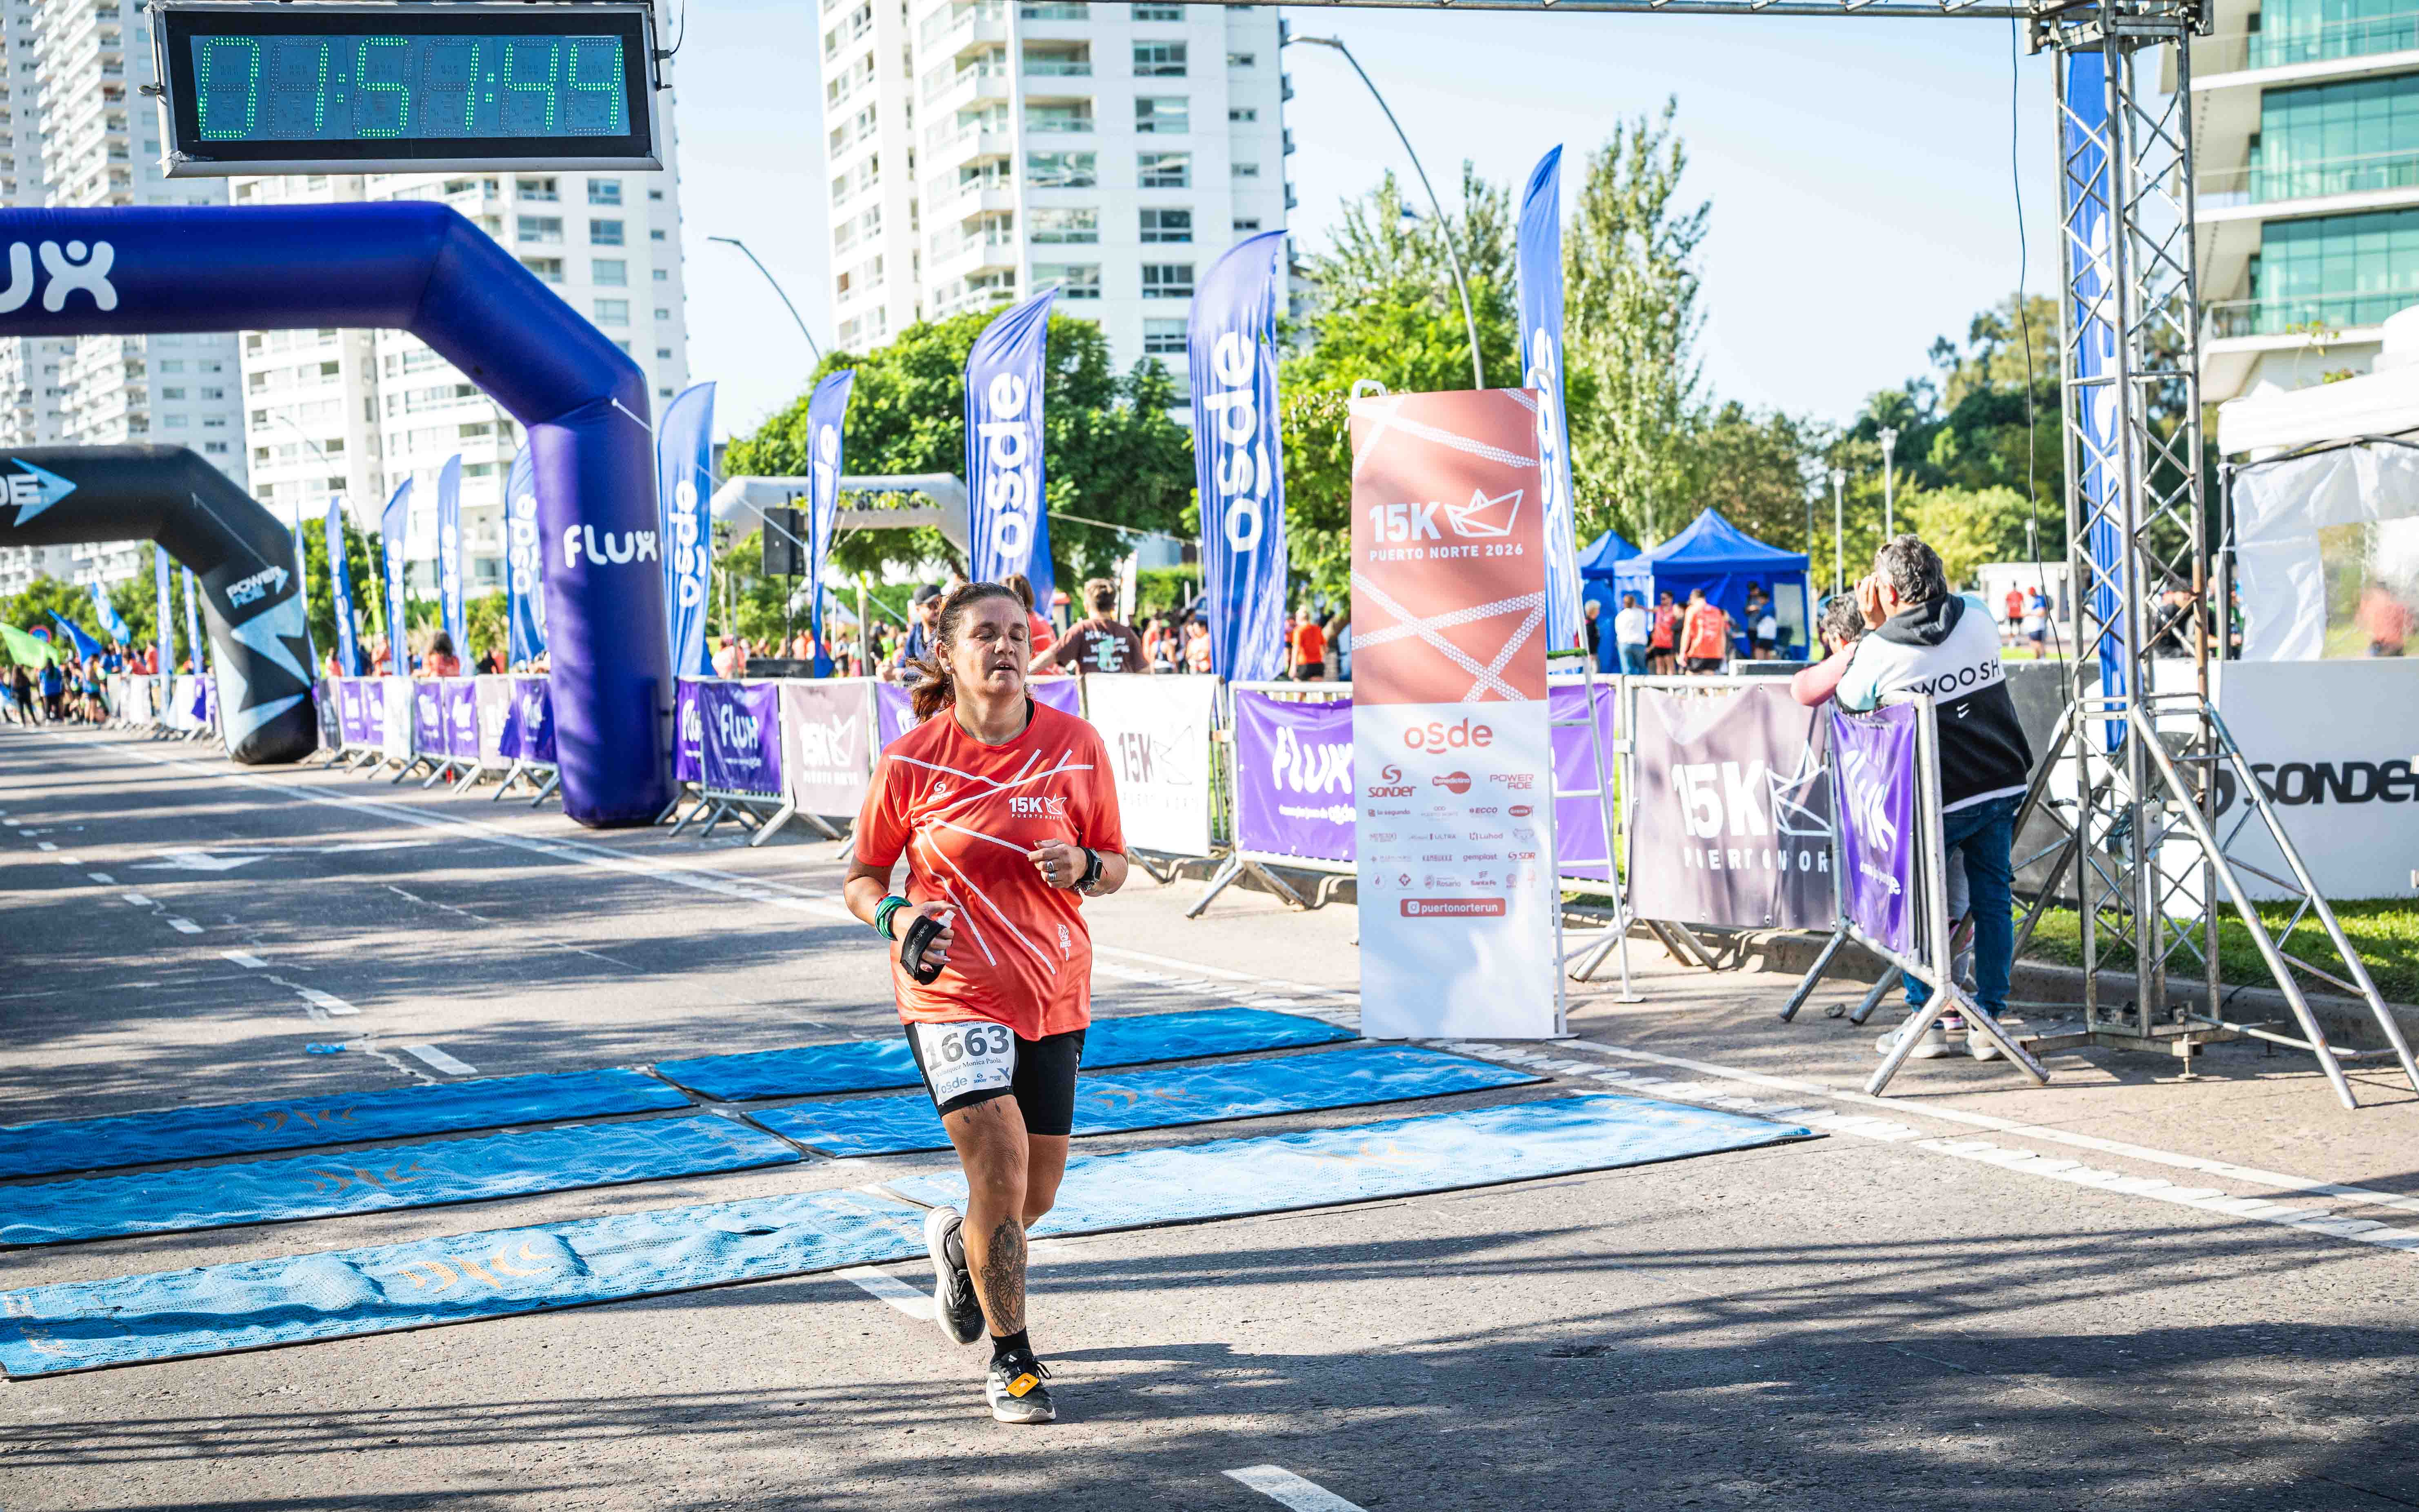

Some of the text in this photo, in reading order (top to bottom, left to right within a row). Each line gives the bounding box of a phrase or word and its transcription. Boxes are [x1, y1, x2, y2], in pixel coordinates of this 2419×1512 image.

[199, 37, 623, 138] 01:51:44
[1204, 331, 1271, 552] osde
[978, 371, 1034, 559] osde
[1369, 502, 1442, 543] 15K
[1370, 543, 1524, 562] PUERTO NORTE 2026
[1895, 656, 2000, 696] WOOSH
[1404, 717, 1493, 754] osde
[1119, 733, 1154, 783] 15K
[1490, 774, 1535, 782] POWER
[1008, 797, 1043, 813] 15K
[1671, 759, 1768, 839] 15K
[1463, 854, 1497, 862] gemplast
[1421, 903, 1498, 915] puertonorterun
[924, 1025, 1009, 1072] 1663
[962, 1058, 985, 1068] Monica
[941, 1077, 968, 1093] osde
